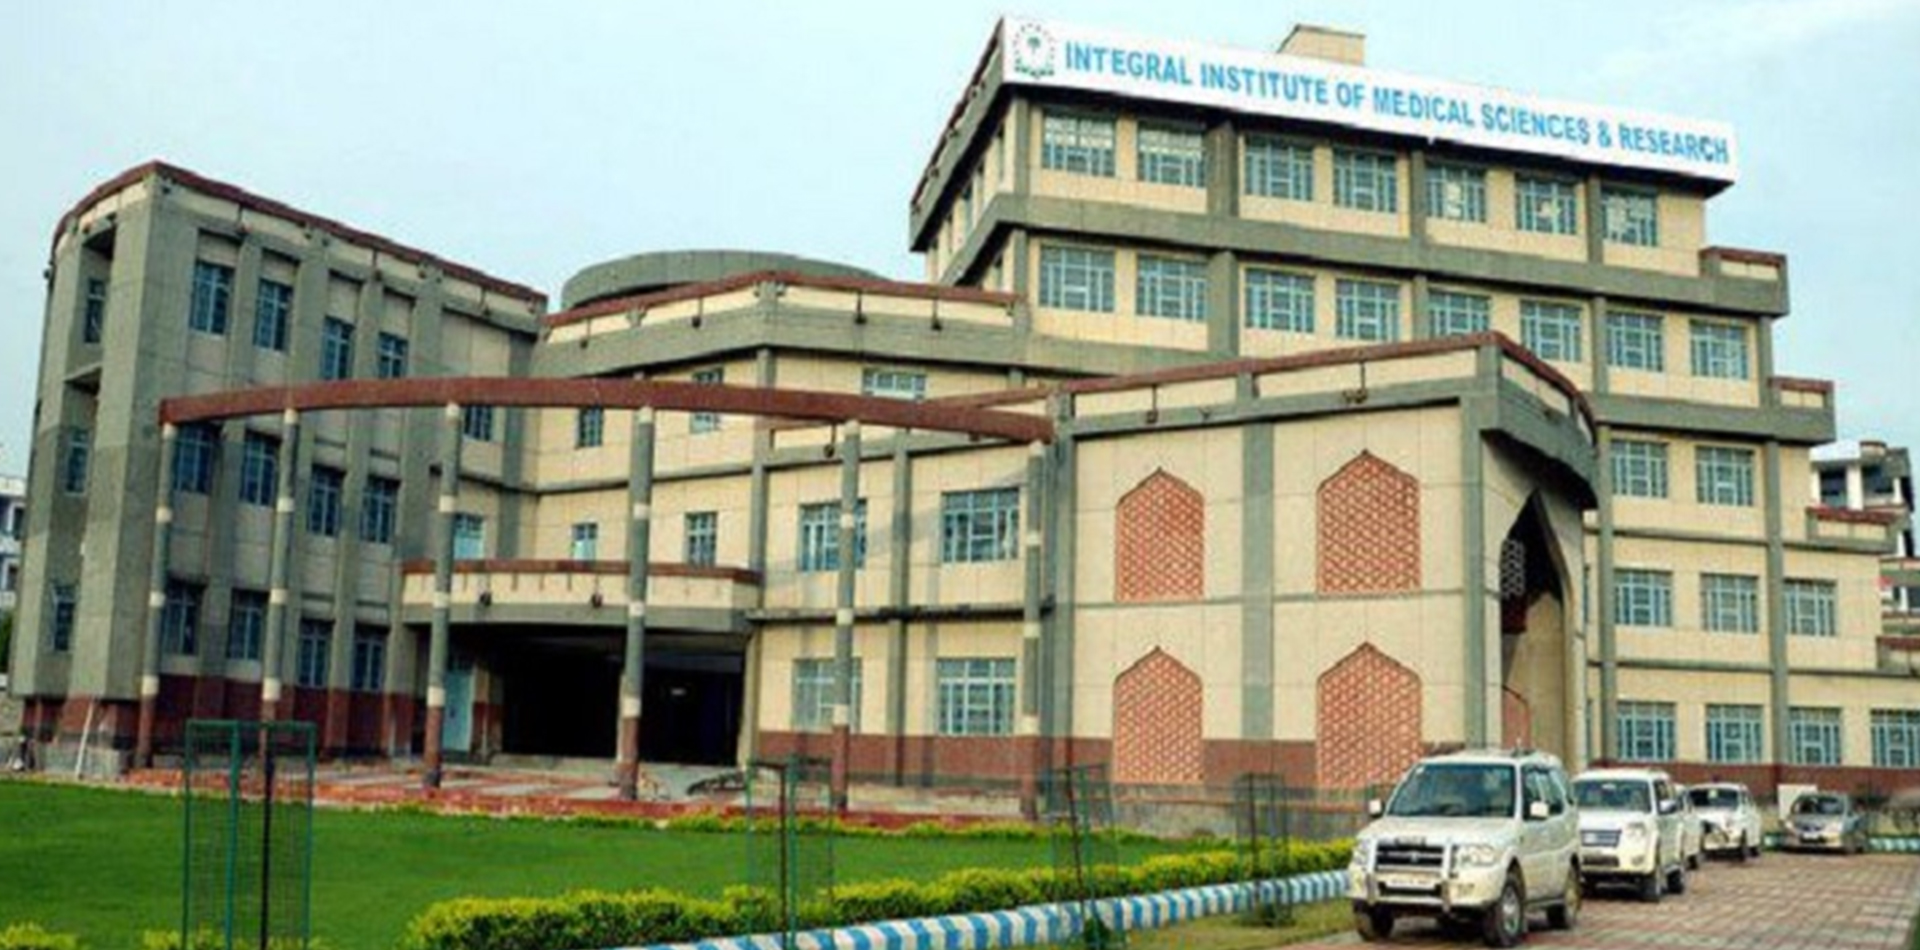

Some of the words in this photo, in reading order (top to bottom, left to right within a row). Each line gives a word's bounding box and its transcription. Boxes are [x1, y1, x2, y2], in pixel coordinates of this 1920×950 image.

[1065, 41, 1192, 85] INTEGRAL
[1200, 63, 1328, 105] INSTITUTE
[1337, 83, 1365, 109] OF
[1373, 86, 1474, 127] MEDICAL
[1481, 102, 1590, 145] SCIENCES
[1598, 121, 1613, 149] &
[1620, 123, 1729, 164] RESEARCH
